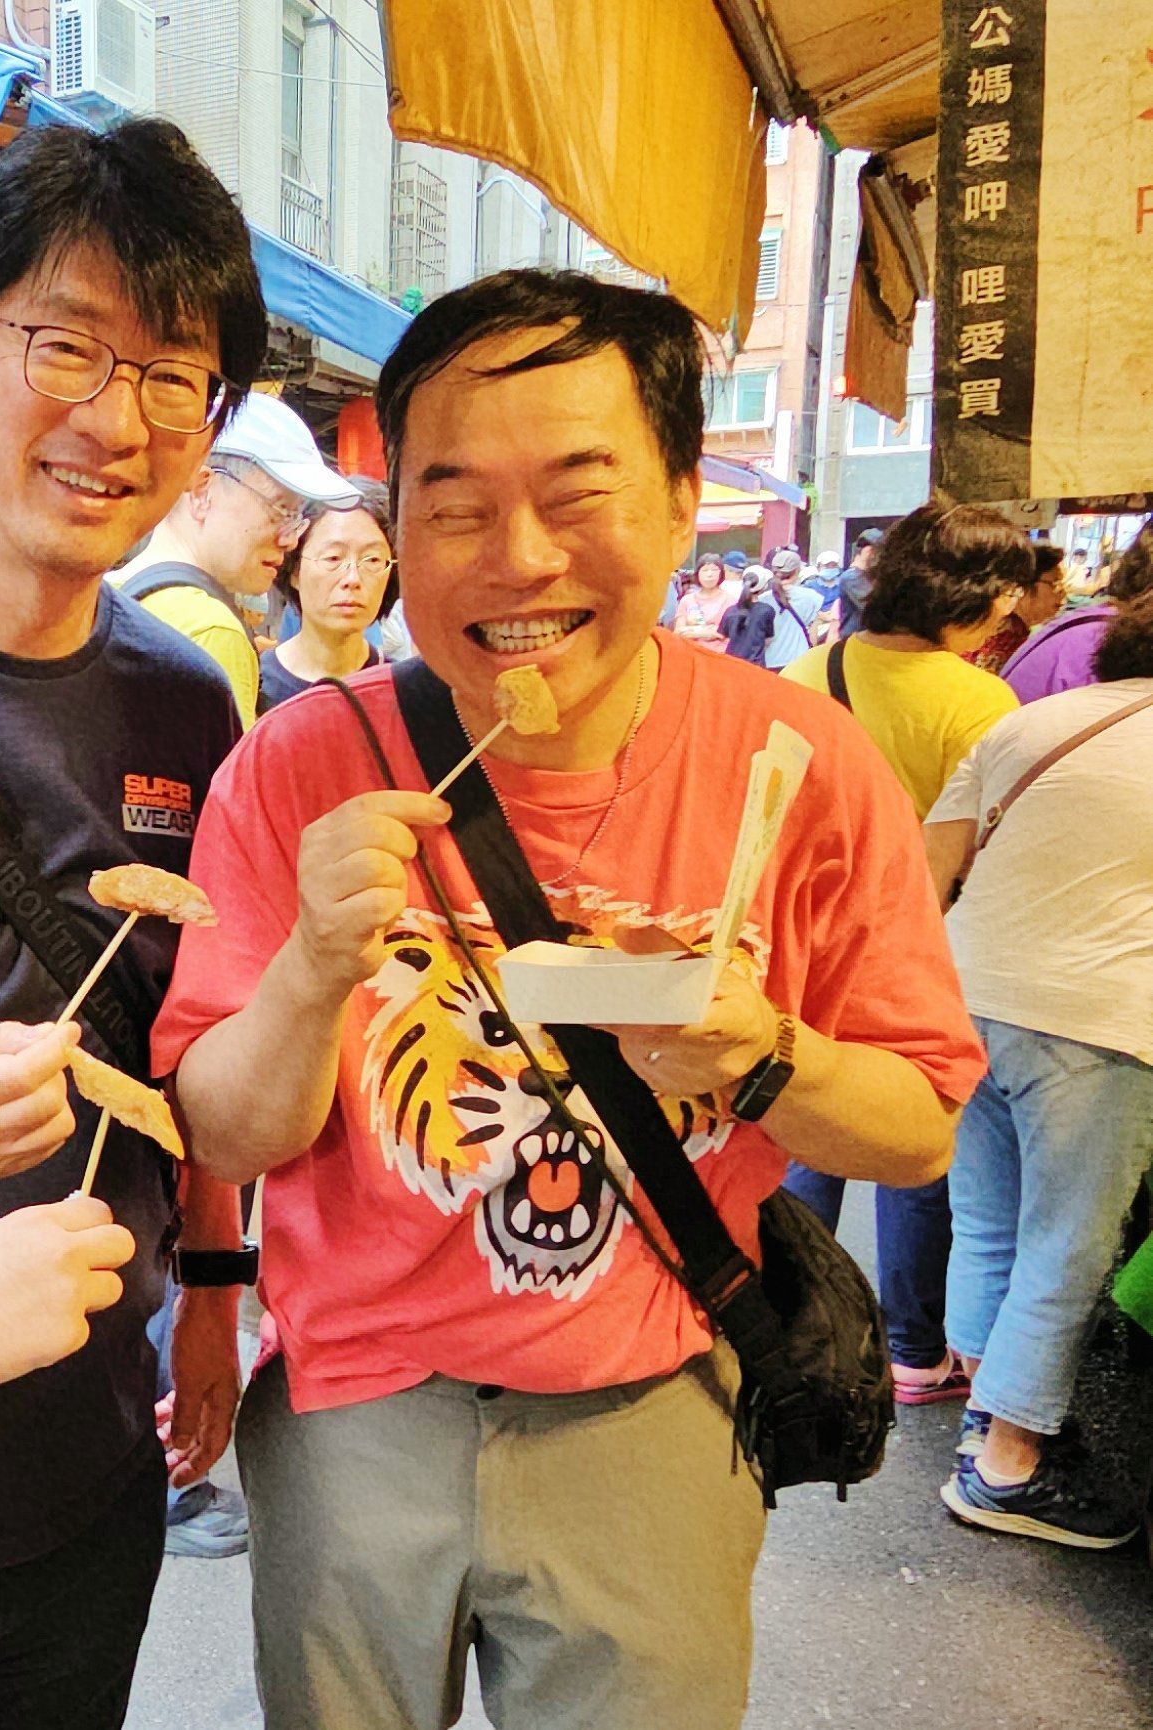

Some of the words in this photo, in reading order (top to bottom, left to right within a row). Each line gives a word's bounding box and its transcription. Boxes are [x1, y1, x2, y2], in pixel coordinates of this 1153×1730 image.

[964, 6, 1013, 222] 公媽愛呷
[957, 264, 1007, 420] 哩愛買
[124, 774, 191, 803] SUPER
